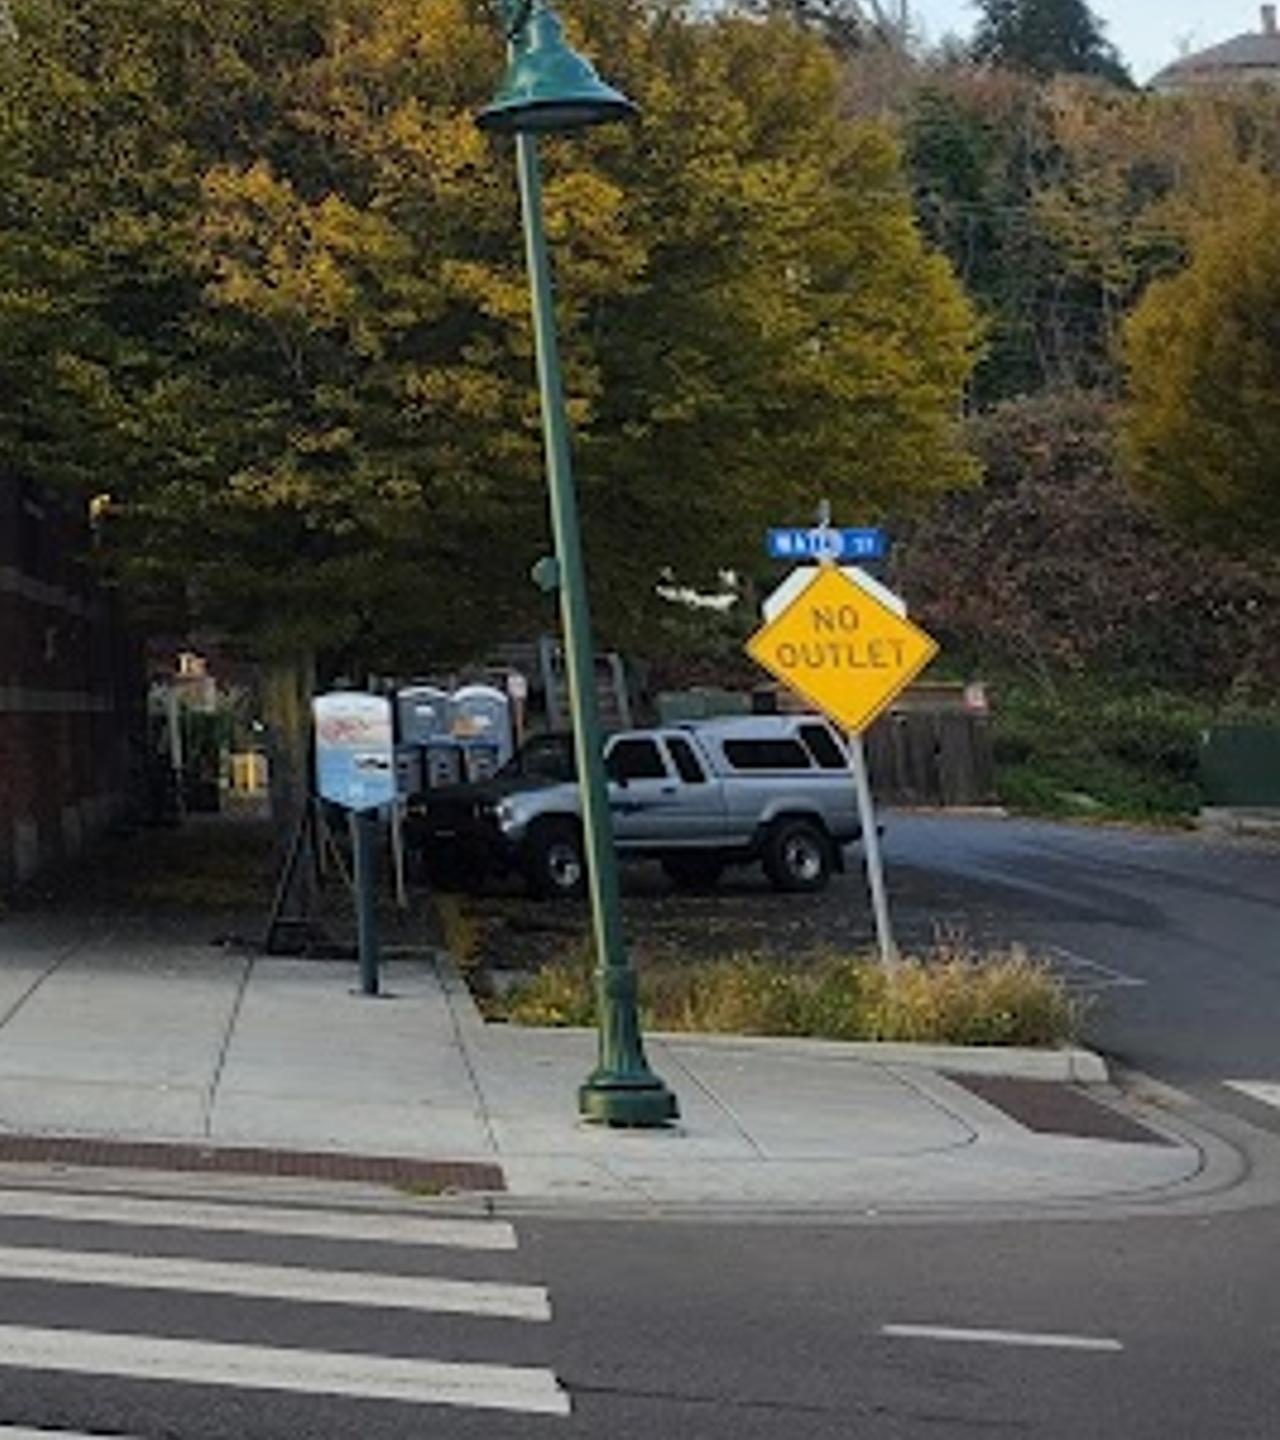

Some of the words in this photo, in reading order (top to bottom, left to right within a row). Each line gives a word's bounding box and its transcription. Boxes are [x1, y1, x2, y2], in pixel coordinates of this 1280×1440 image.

[774, 532, 842, 554] WAT
[811, 604, 860, 633] NO
[775, 638, 907, 669] OUTLET
